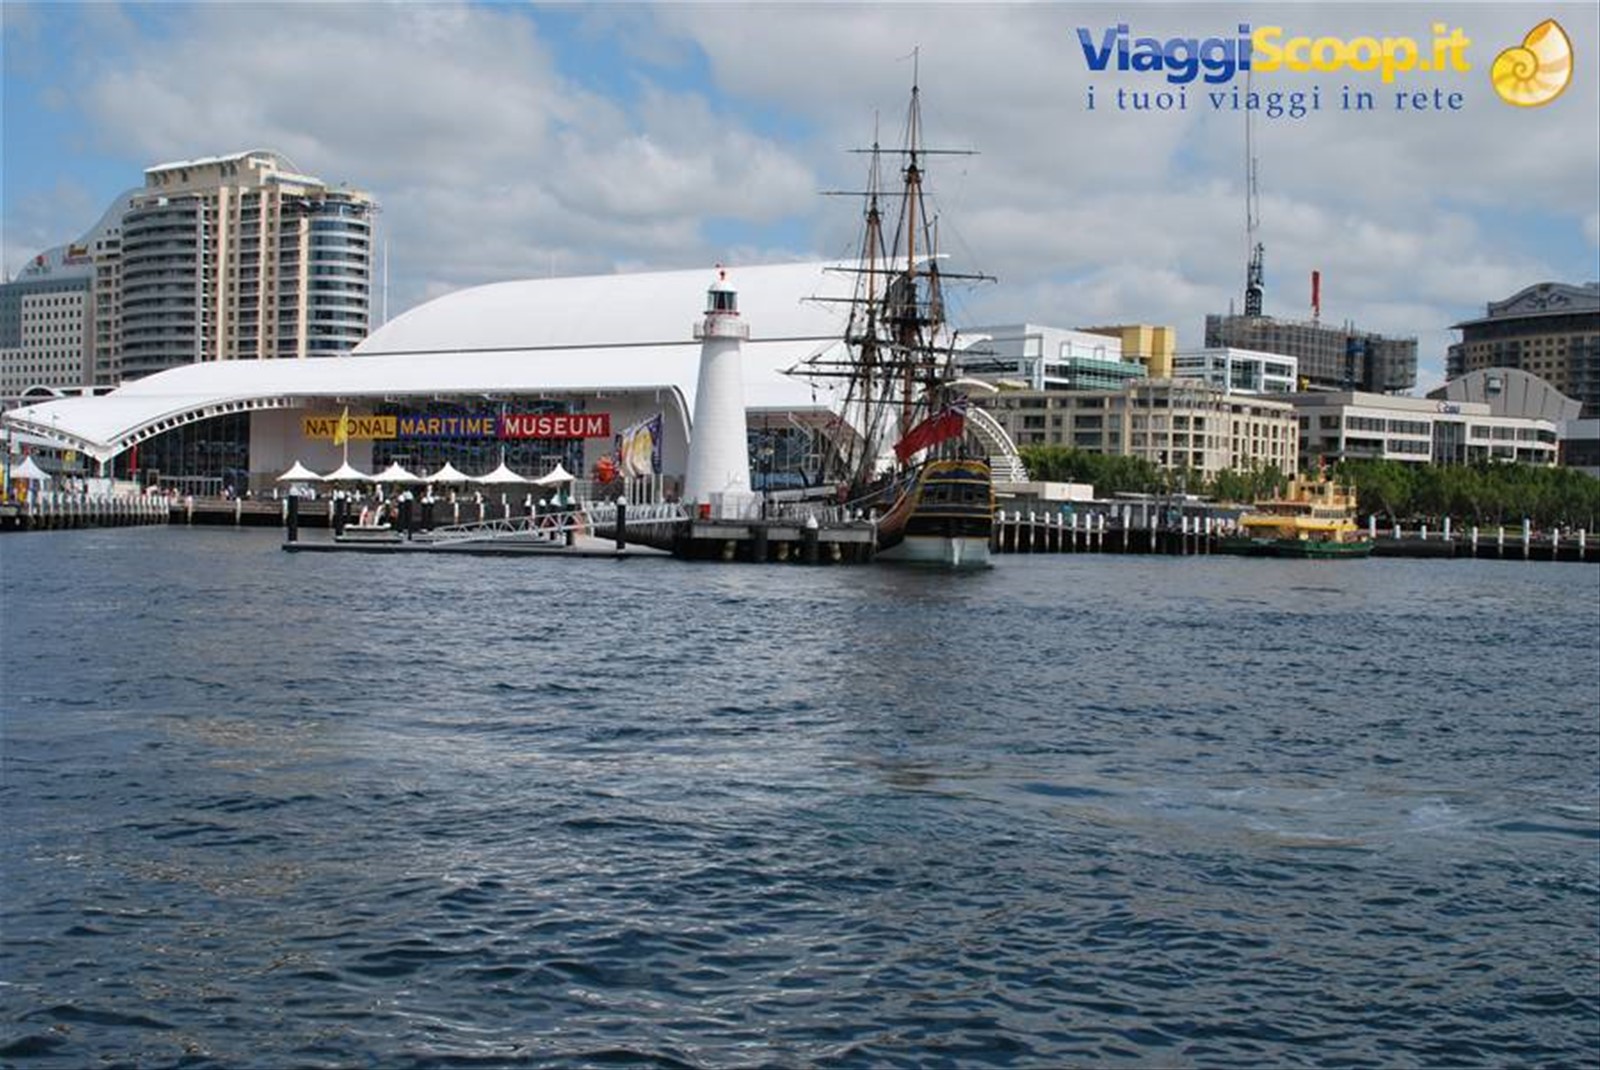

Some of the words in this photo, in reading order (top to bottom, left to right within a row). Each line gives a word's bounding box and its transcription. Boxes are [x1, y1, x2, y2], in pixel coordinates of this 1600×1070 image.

[305, 419, 394, 436] NATONAL
[401, 417, 496, 435] MARITIME
[505, 416, 603, 434] MUSEUM
